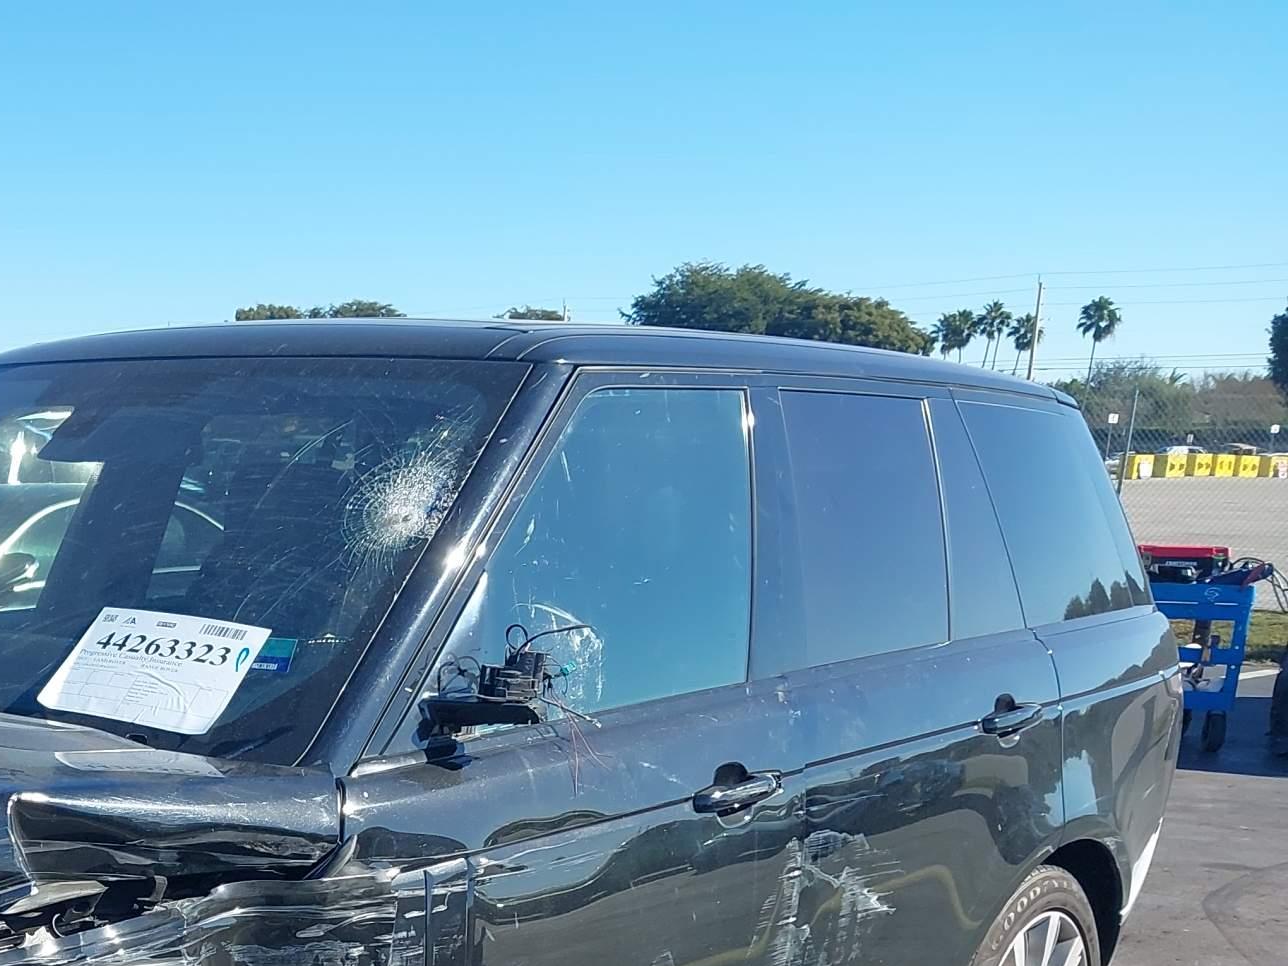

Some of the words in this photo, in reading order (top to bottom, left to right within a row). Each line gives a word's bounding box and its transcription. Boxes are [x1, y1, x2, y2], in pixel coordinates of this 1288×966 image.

[79, 648, 119, 659] Progressive
[118, 652, 149, 664] Casualty
[149, 657, 183, 667] Insurance
[96, 631, 232, 667] 44263323
